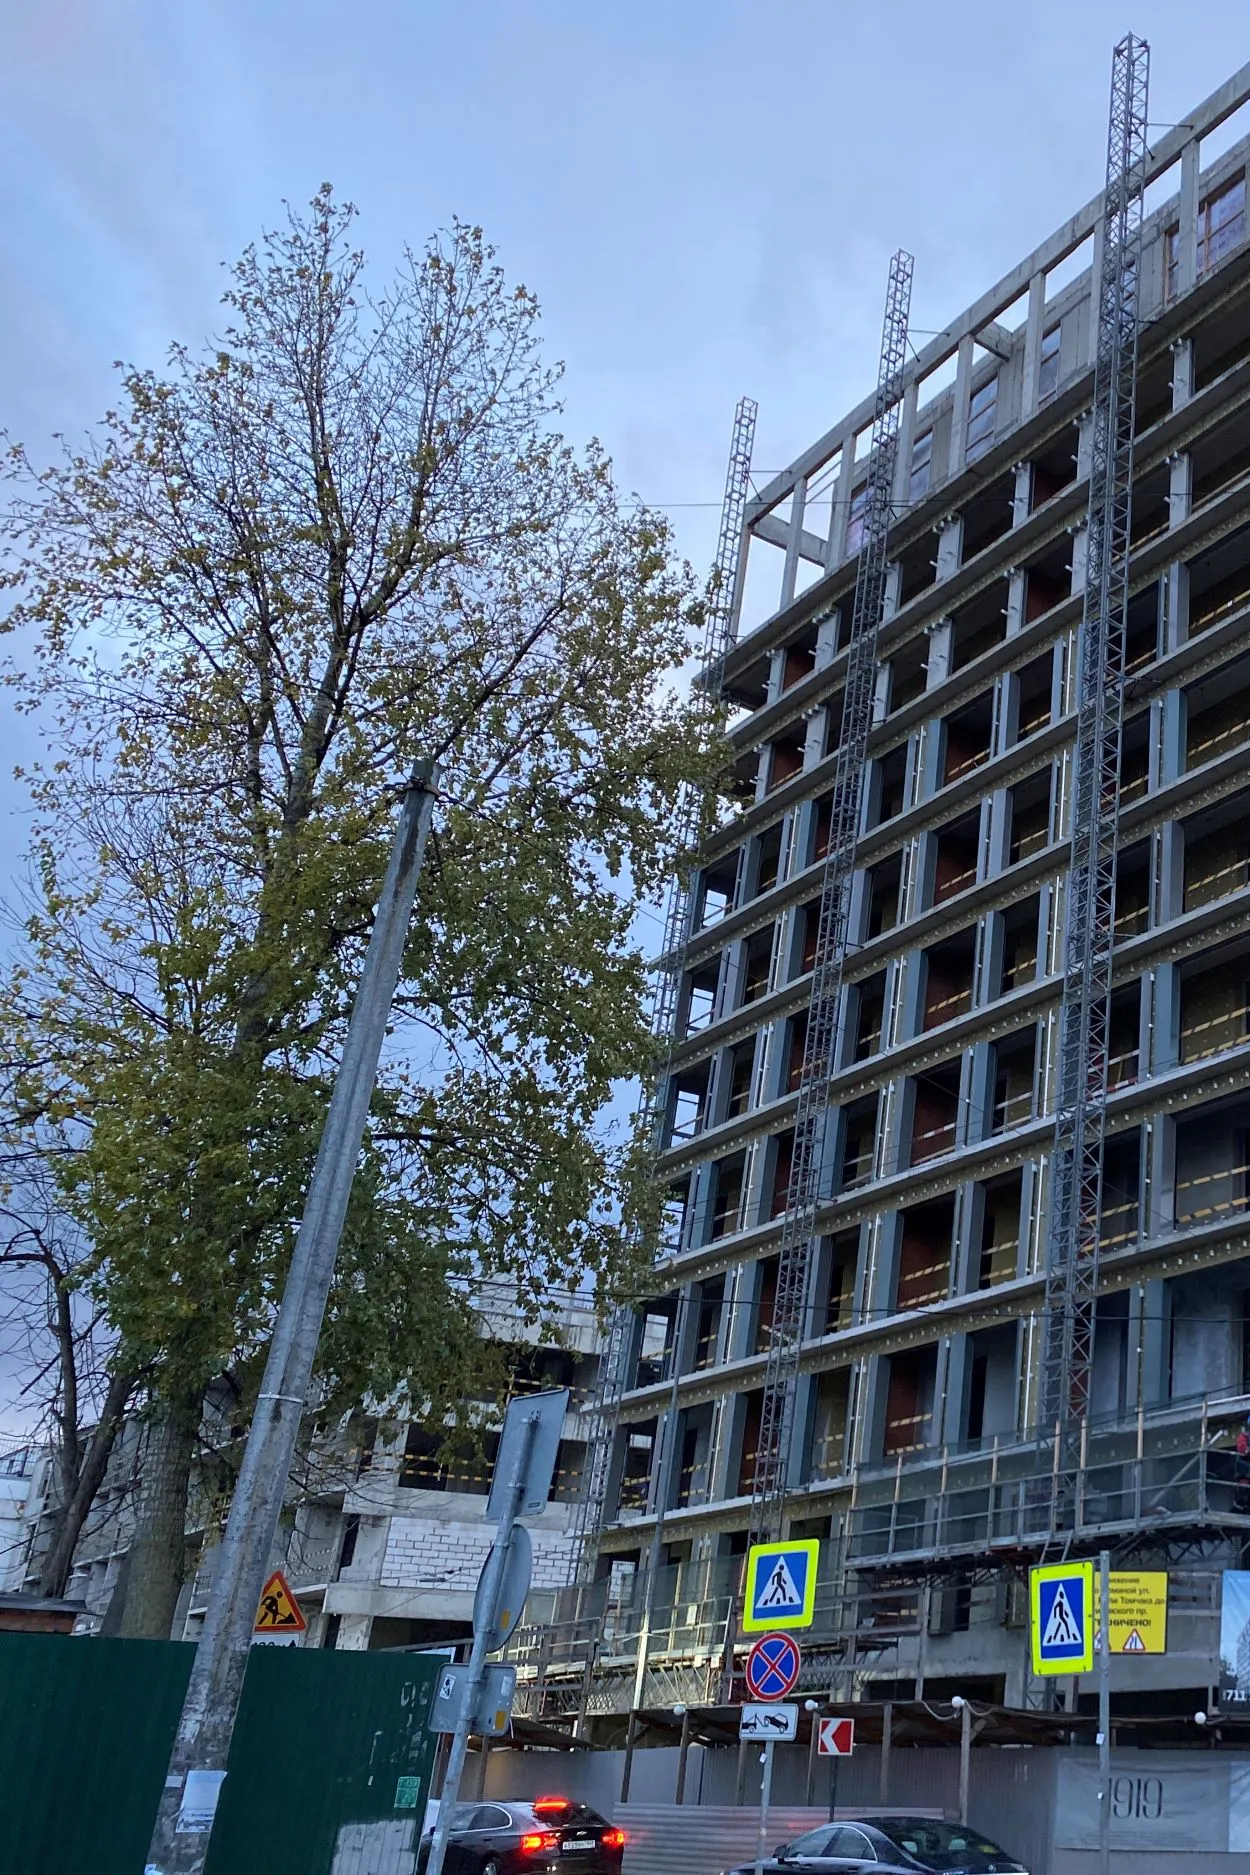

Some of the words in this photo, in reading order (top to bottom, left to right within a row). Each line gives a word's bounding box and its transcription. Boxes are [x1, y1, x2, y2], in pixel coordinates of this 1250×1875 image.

[1109, 1586, 1137, 1594] маной
[1120, 1596, 1153, 1604] Томчака
[1226, 1689, 1247, 1702] 711
